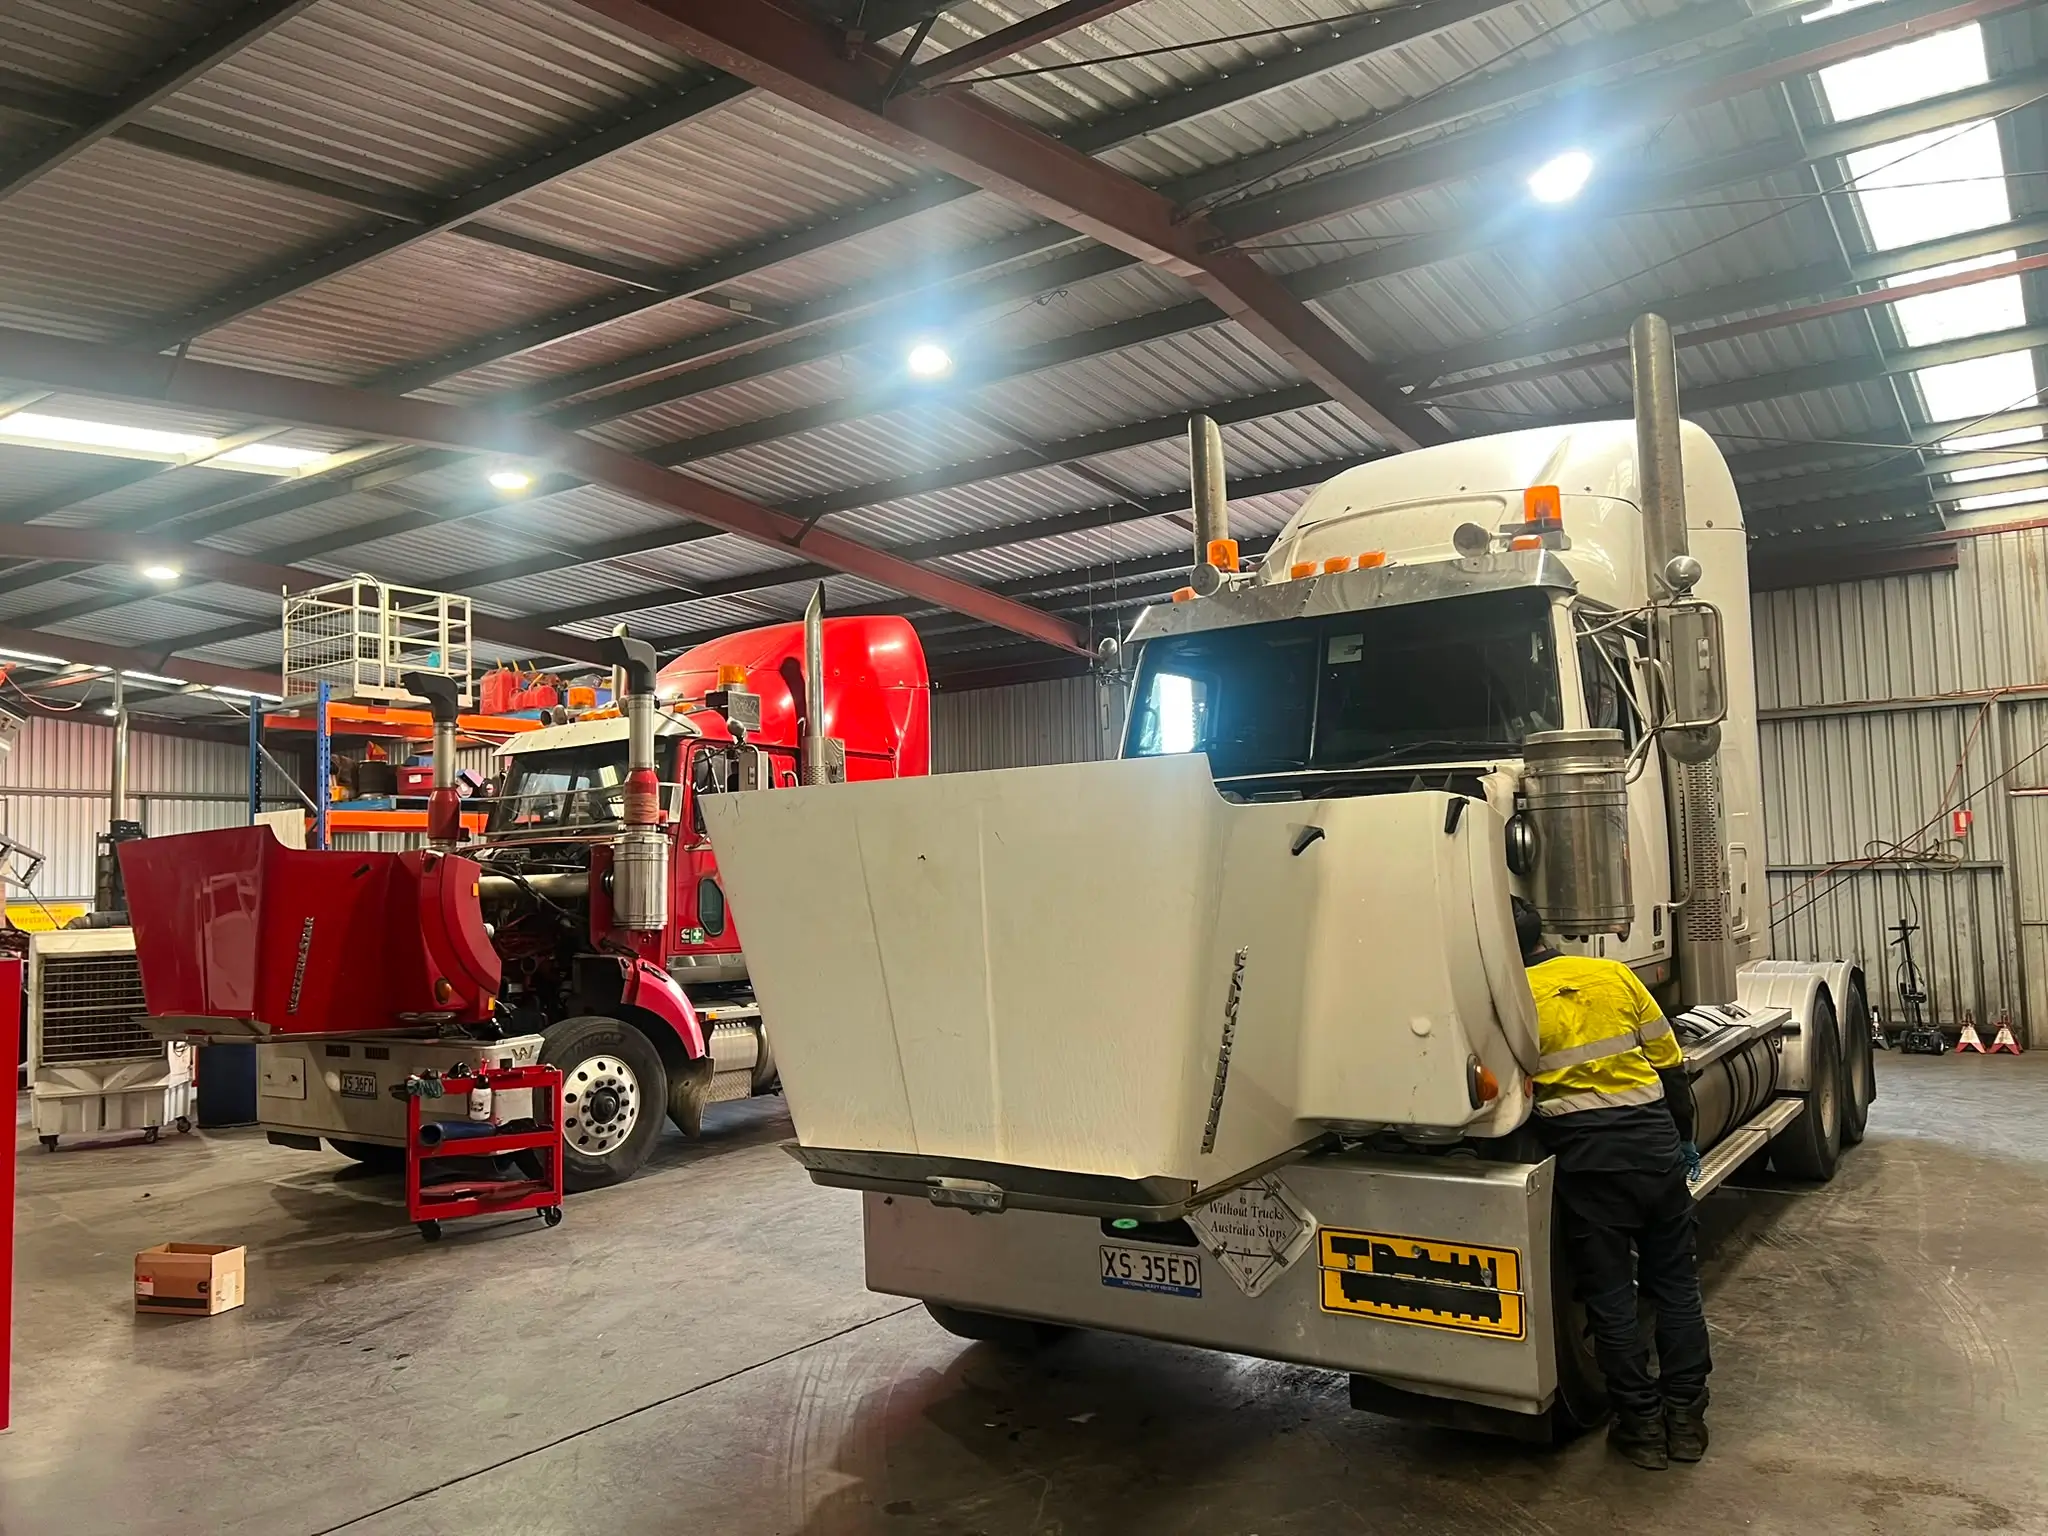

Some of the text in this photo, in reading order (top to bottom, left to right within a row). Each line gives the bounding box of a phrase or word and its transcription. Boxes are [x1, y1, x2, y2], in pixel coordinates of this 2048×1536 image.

[1224, 945, 1249, 1018] STAR
[1209, 1201, 1285, 1221] Without Trucks
[1211, 1220, 1287, 1242] Australia Stops
